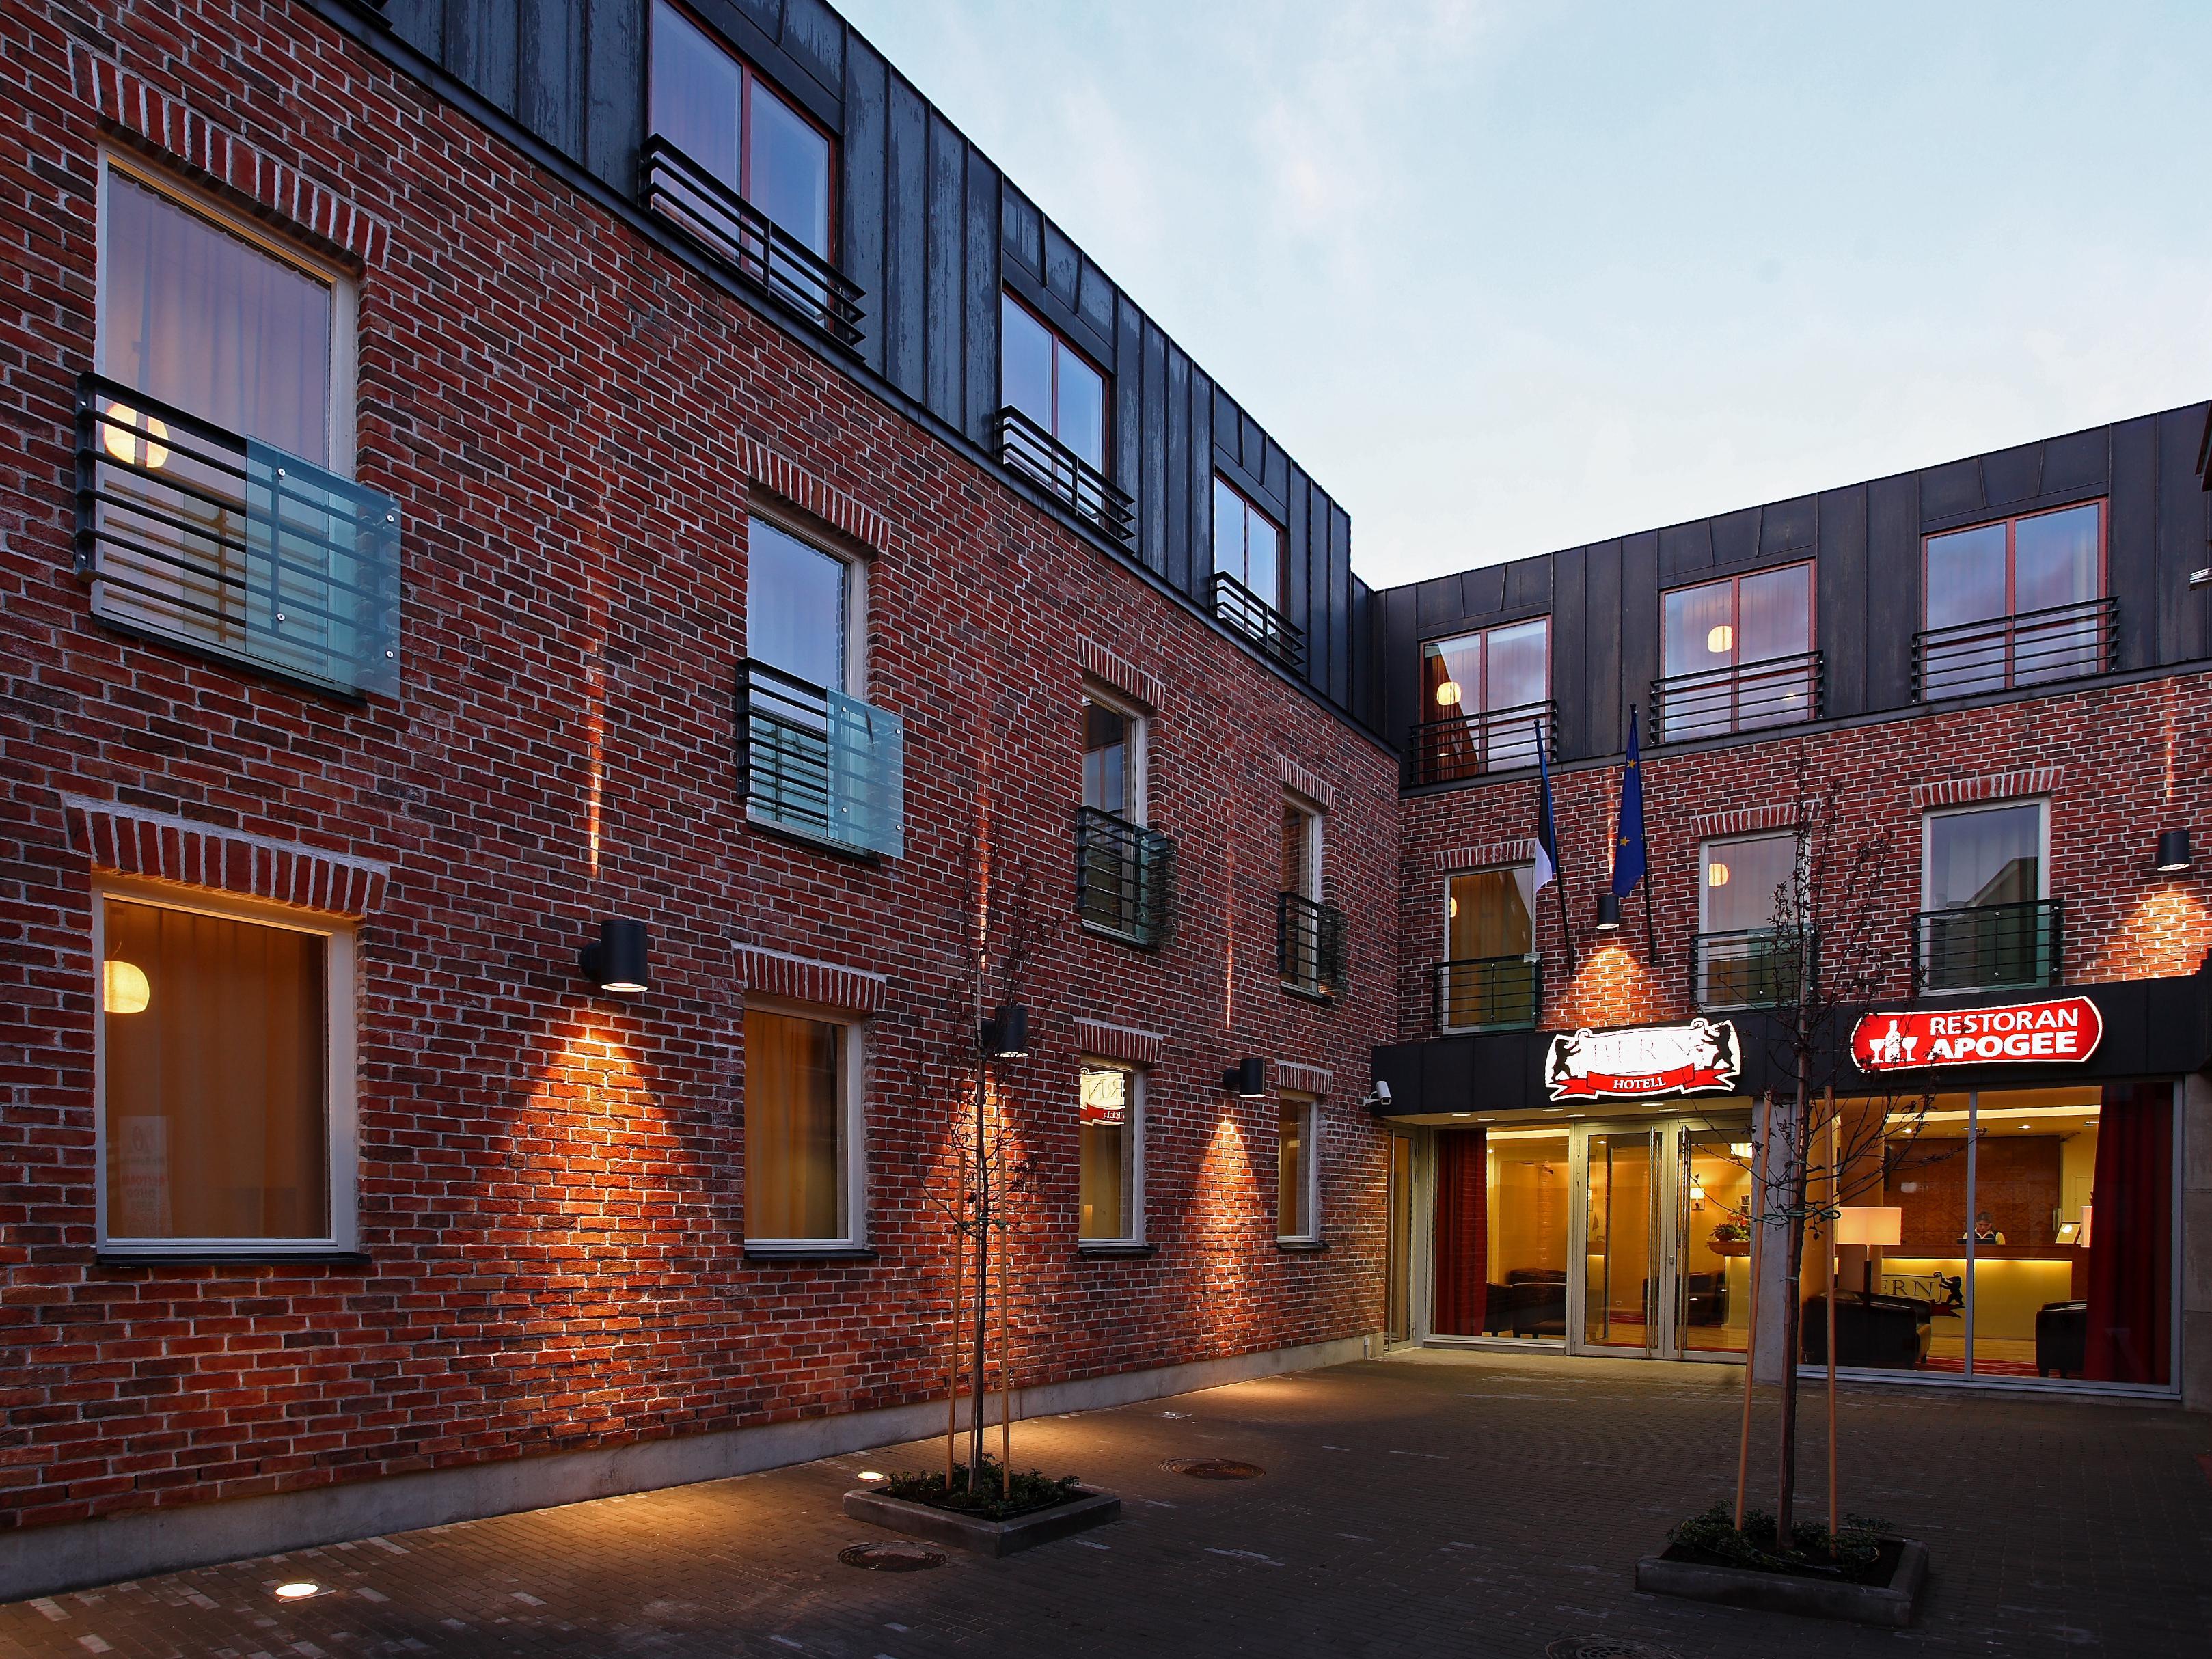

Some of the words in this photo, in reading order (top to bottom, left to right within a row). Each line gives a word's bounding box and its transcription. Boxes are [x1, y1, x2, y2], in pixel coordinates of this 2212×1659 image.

[1930, 1007, 2079, 1036] RESTORAN
[1927, 1030, 2078, 1060] APOGEE
[1613, 1077, 1667, 1089] HOTELL
